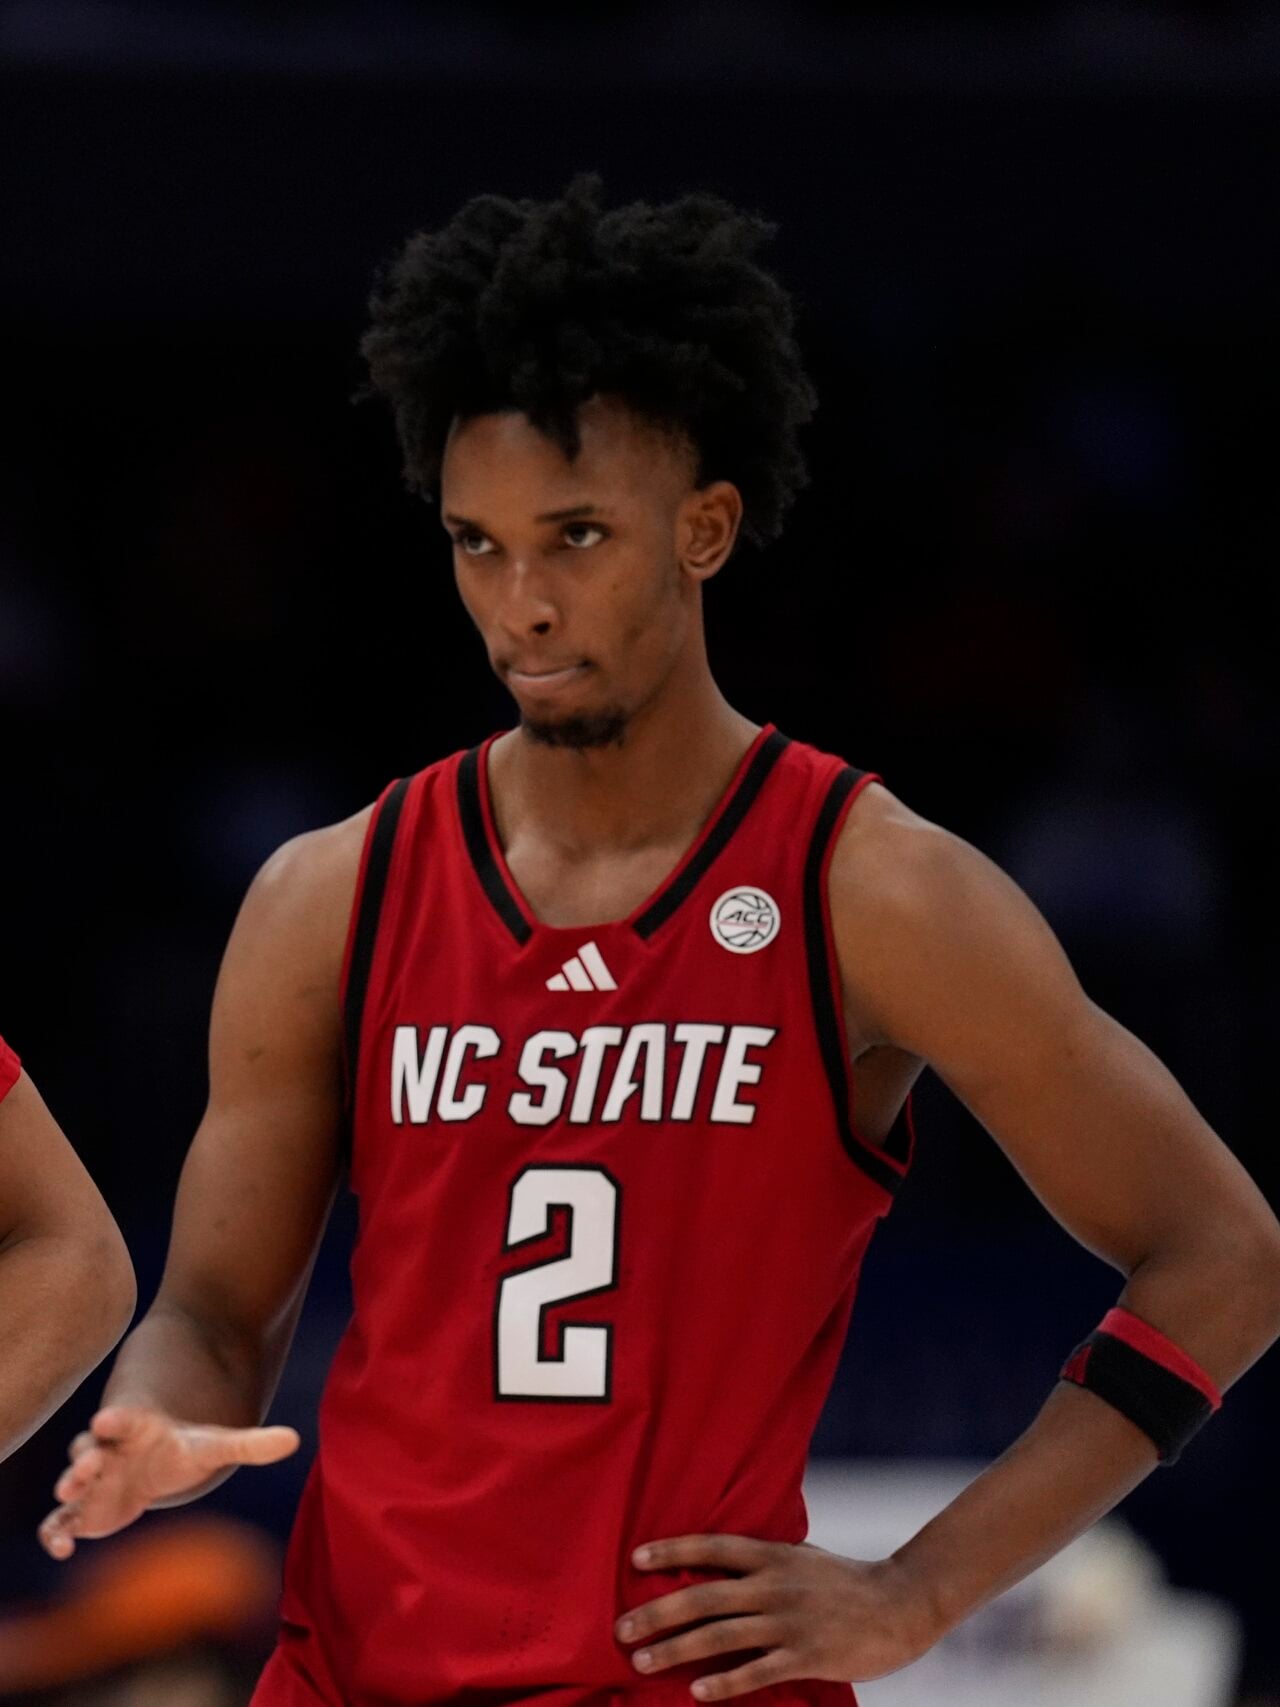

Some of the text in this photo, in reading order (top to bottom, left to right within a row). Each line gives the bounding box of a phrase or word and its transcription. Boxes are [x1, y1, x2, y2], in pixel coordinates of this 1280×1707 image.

[724, 910, 773, 925] ACC
[389, 1021, 778, 1127] NC STATE
[493, 1164, 619, 1402] 2
